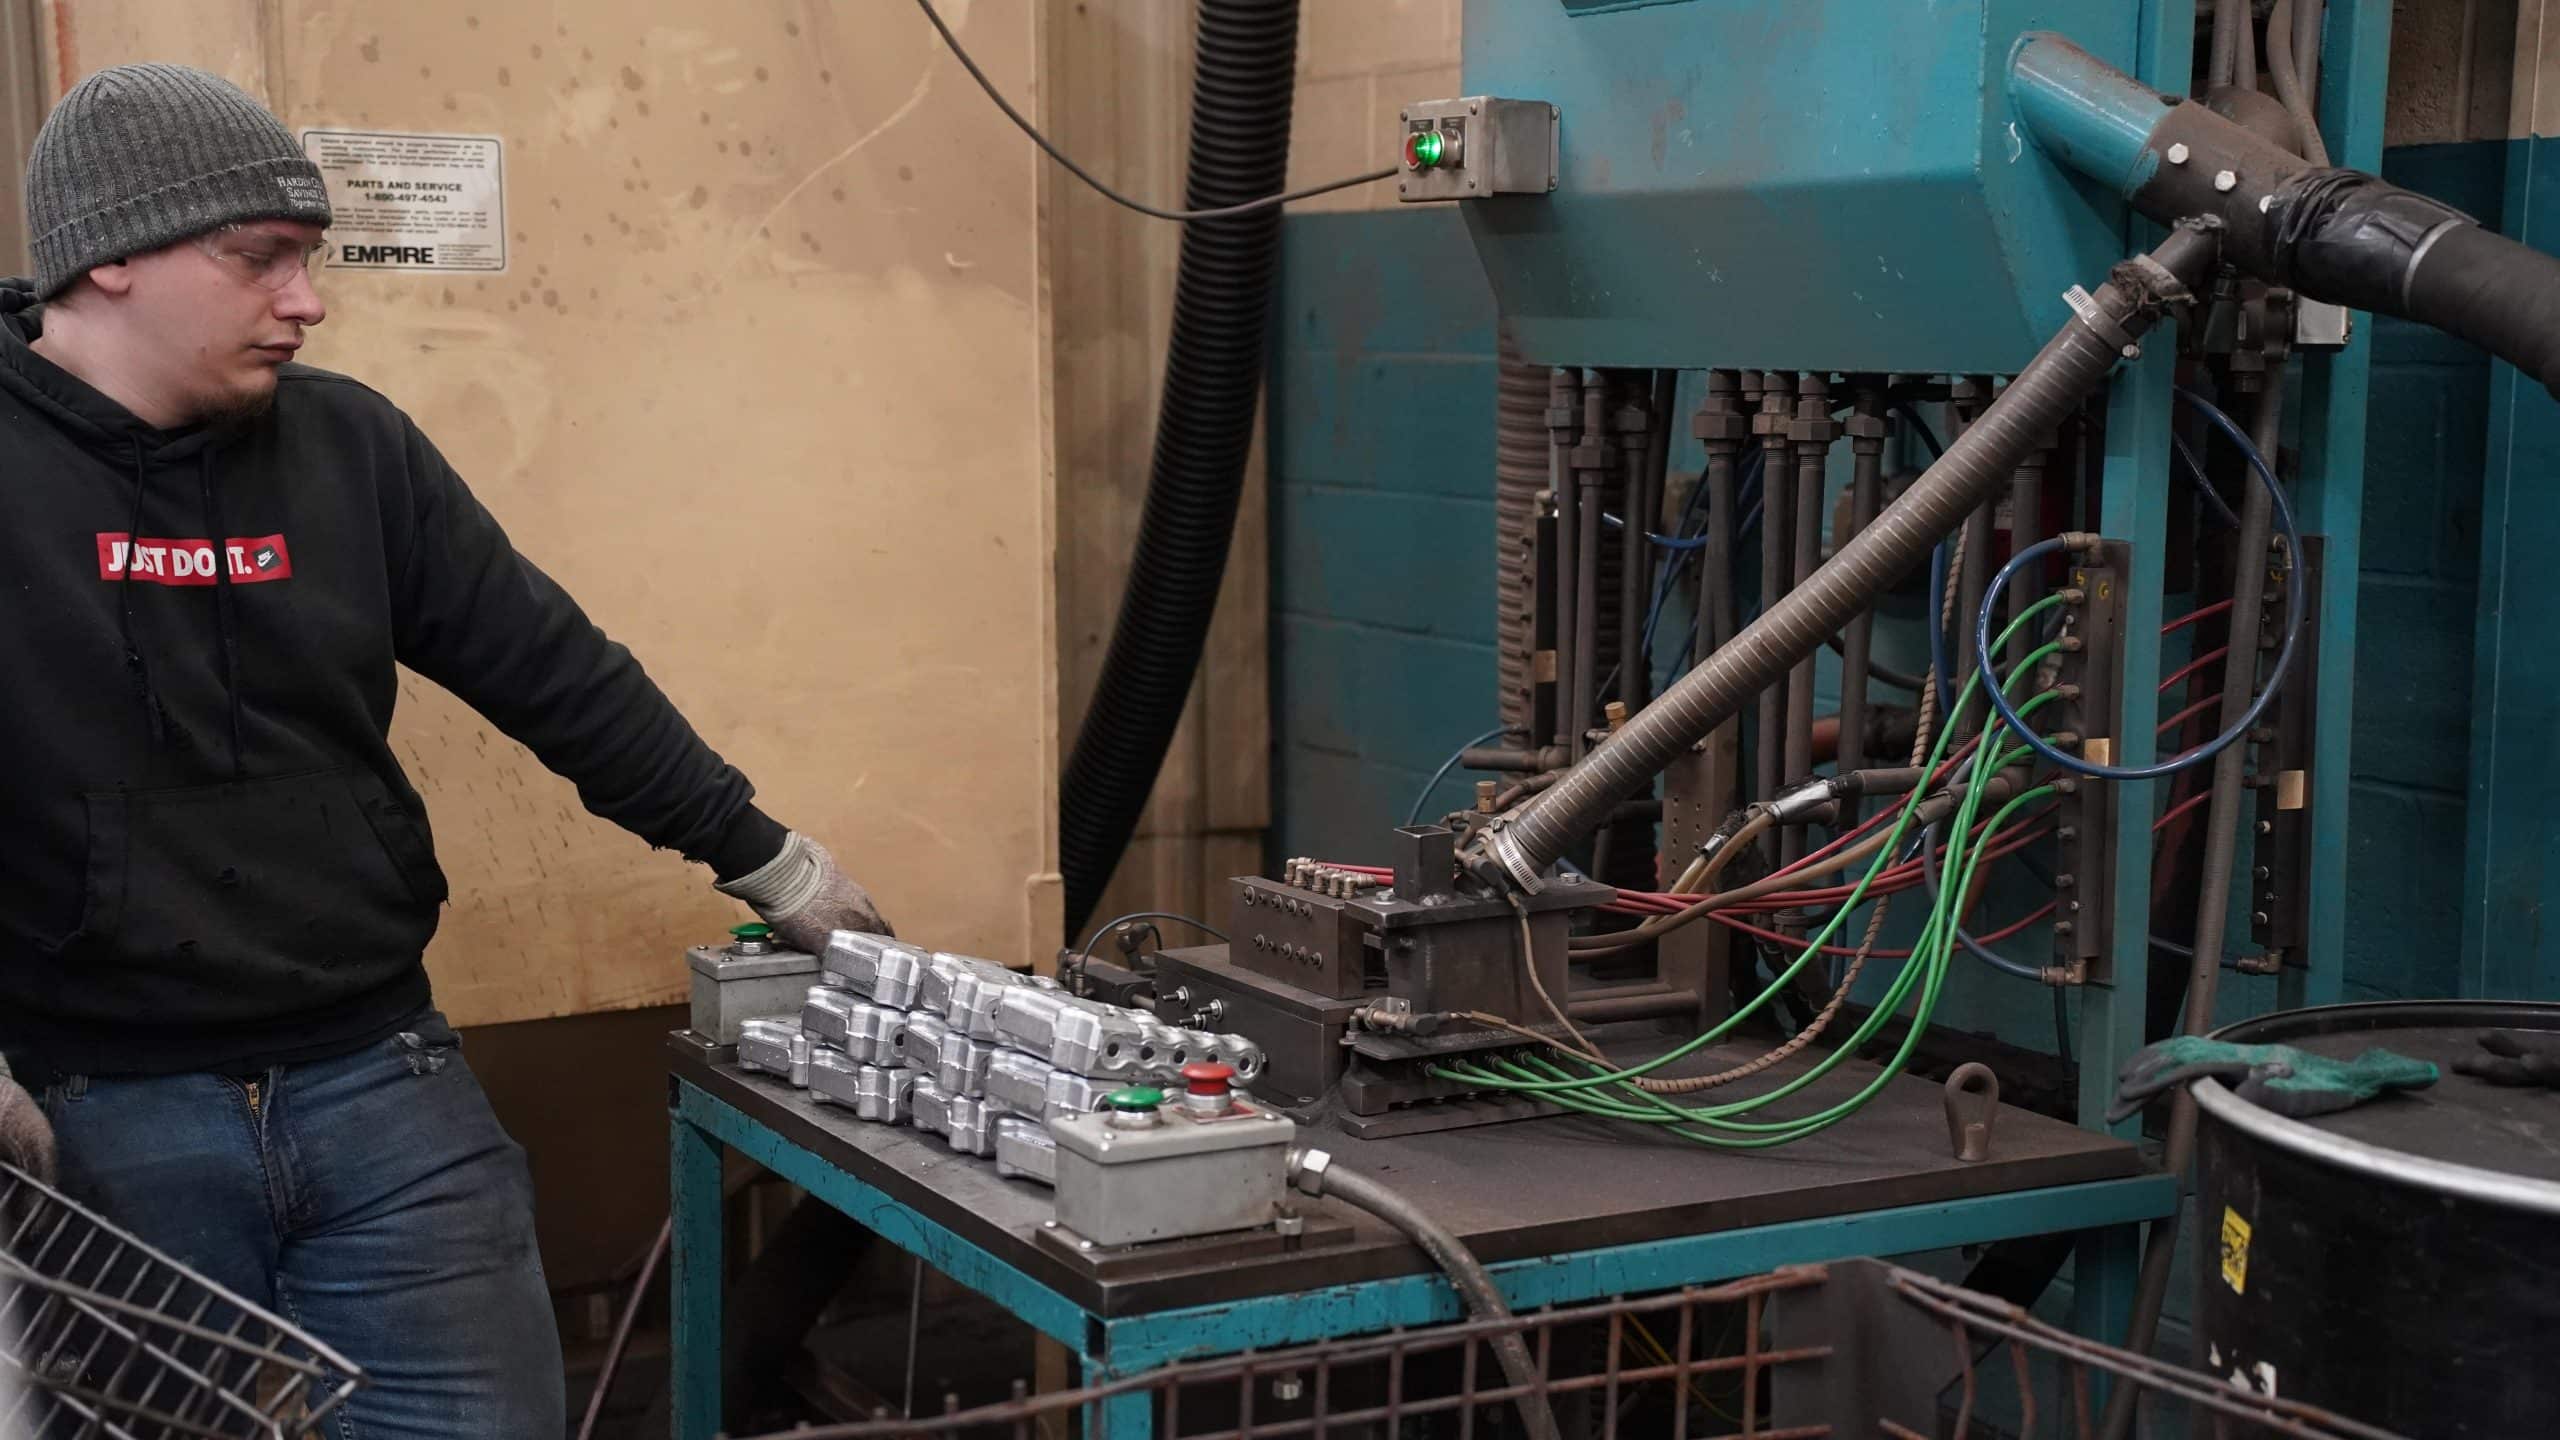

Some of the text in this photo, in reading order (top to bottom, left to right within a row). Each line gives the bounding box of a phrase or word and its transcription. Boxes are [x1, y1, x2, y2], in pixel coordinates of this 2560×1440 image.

[347, 179, 463, 192] PARTS AND SERVICE
[364, 192, 448, 203] 1-800-497-4543
[342, 245, 435, 264] EMPIRE
[108, 541, 167, 576] JUST
[173, 548, 216, 577] DO
